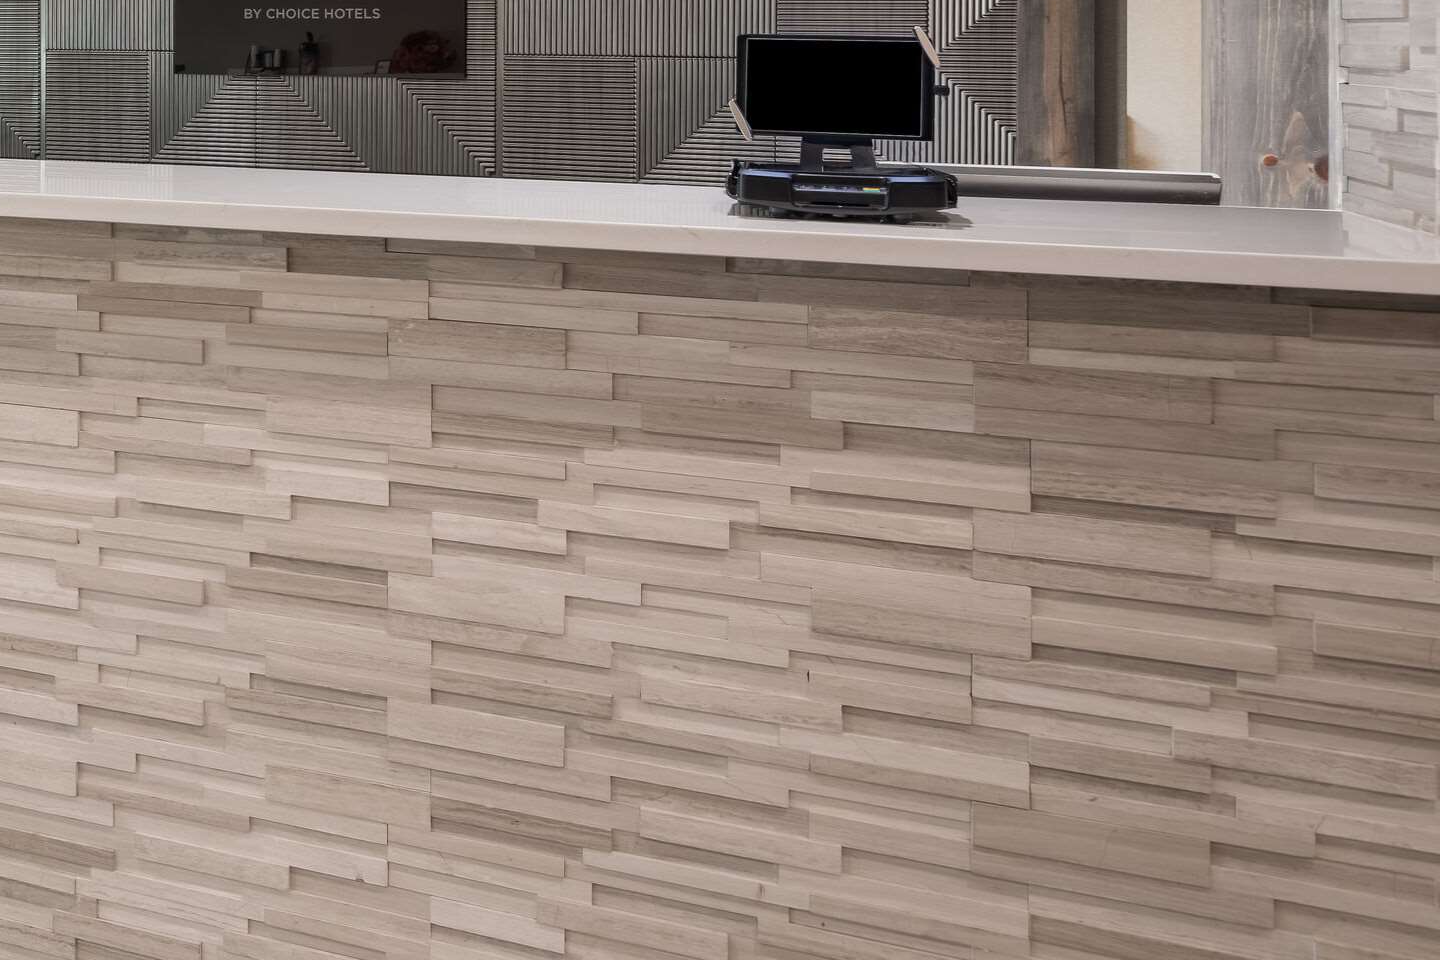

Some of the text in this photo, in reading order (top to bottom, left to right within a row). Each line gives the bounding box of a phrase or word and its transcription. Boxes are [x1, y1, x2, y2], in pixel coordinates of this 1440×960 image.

[244, 7, 381, 20] BY CHOICE HOTELS
